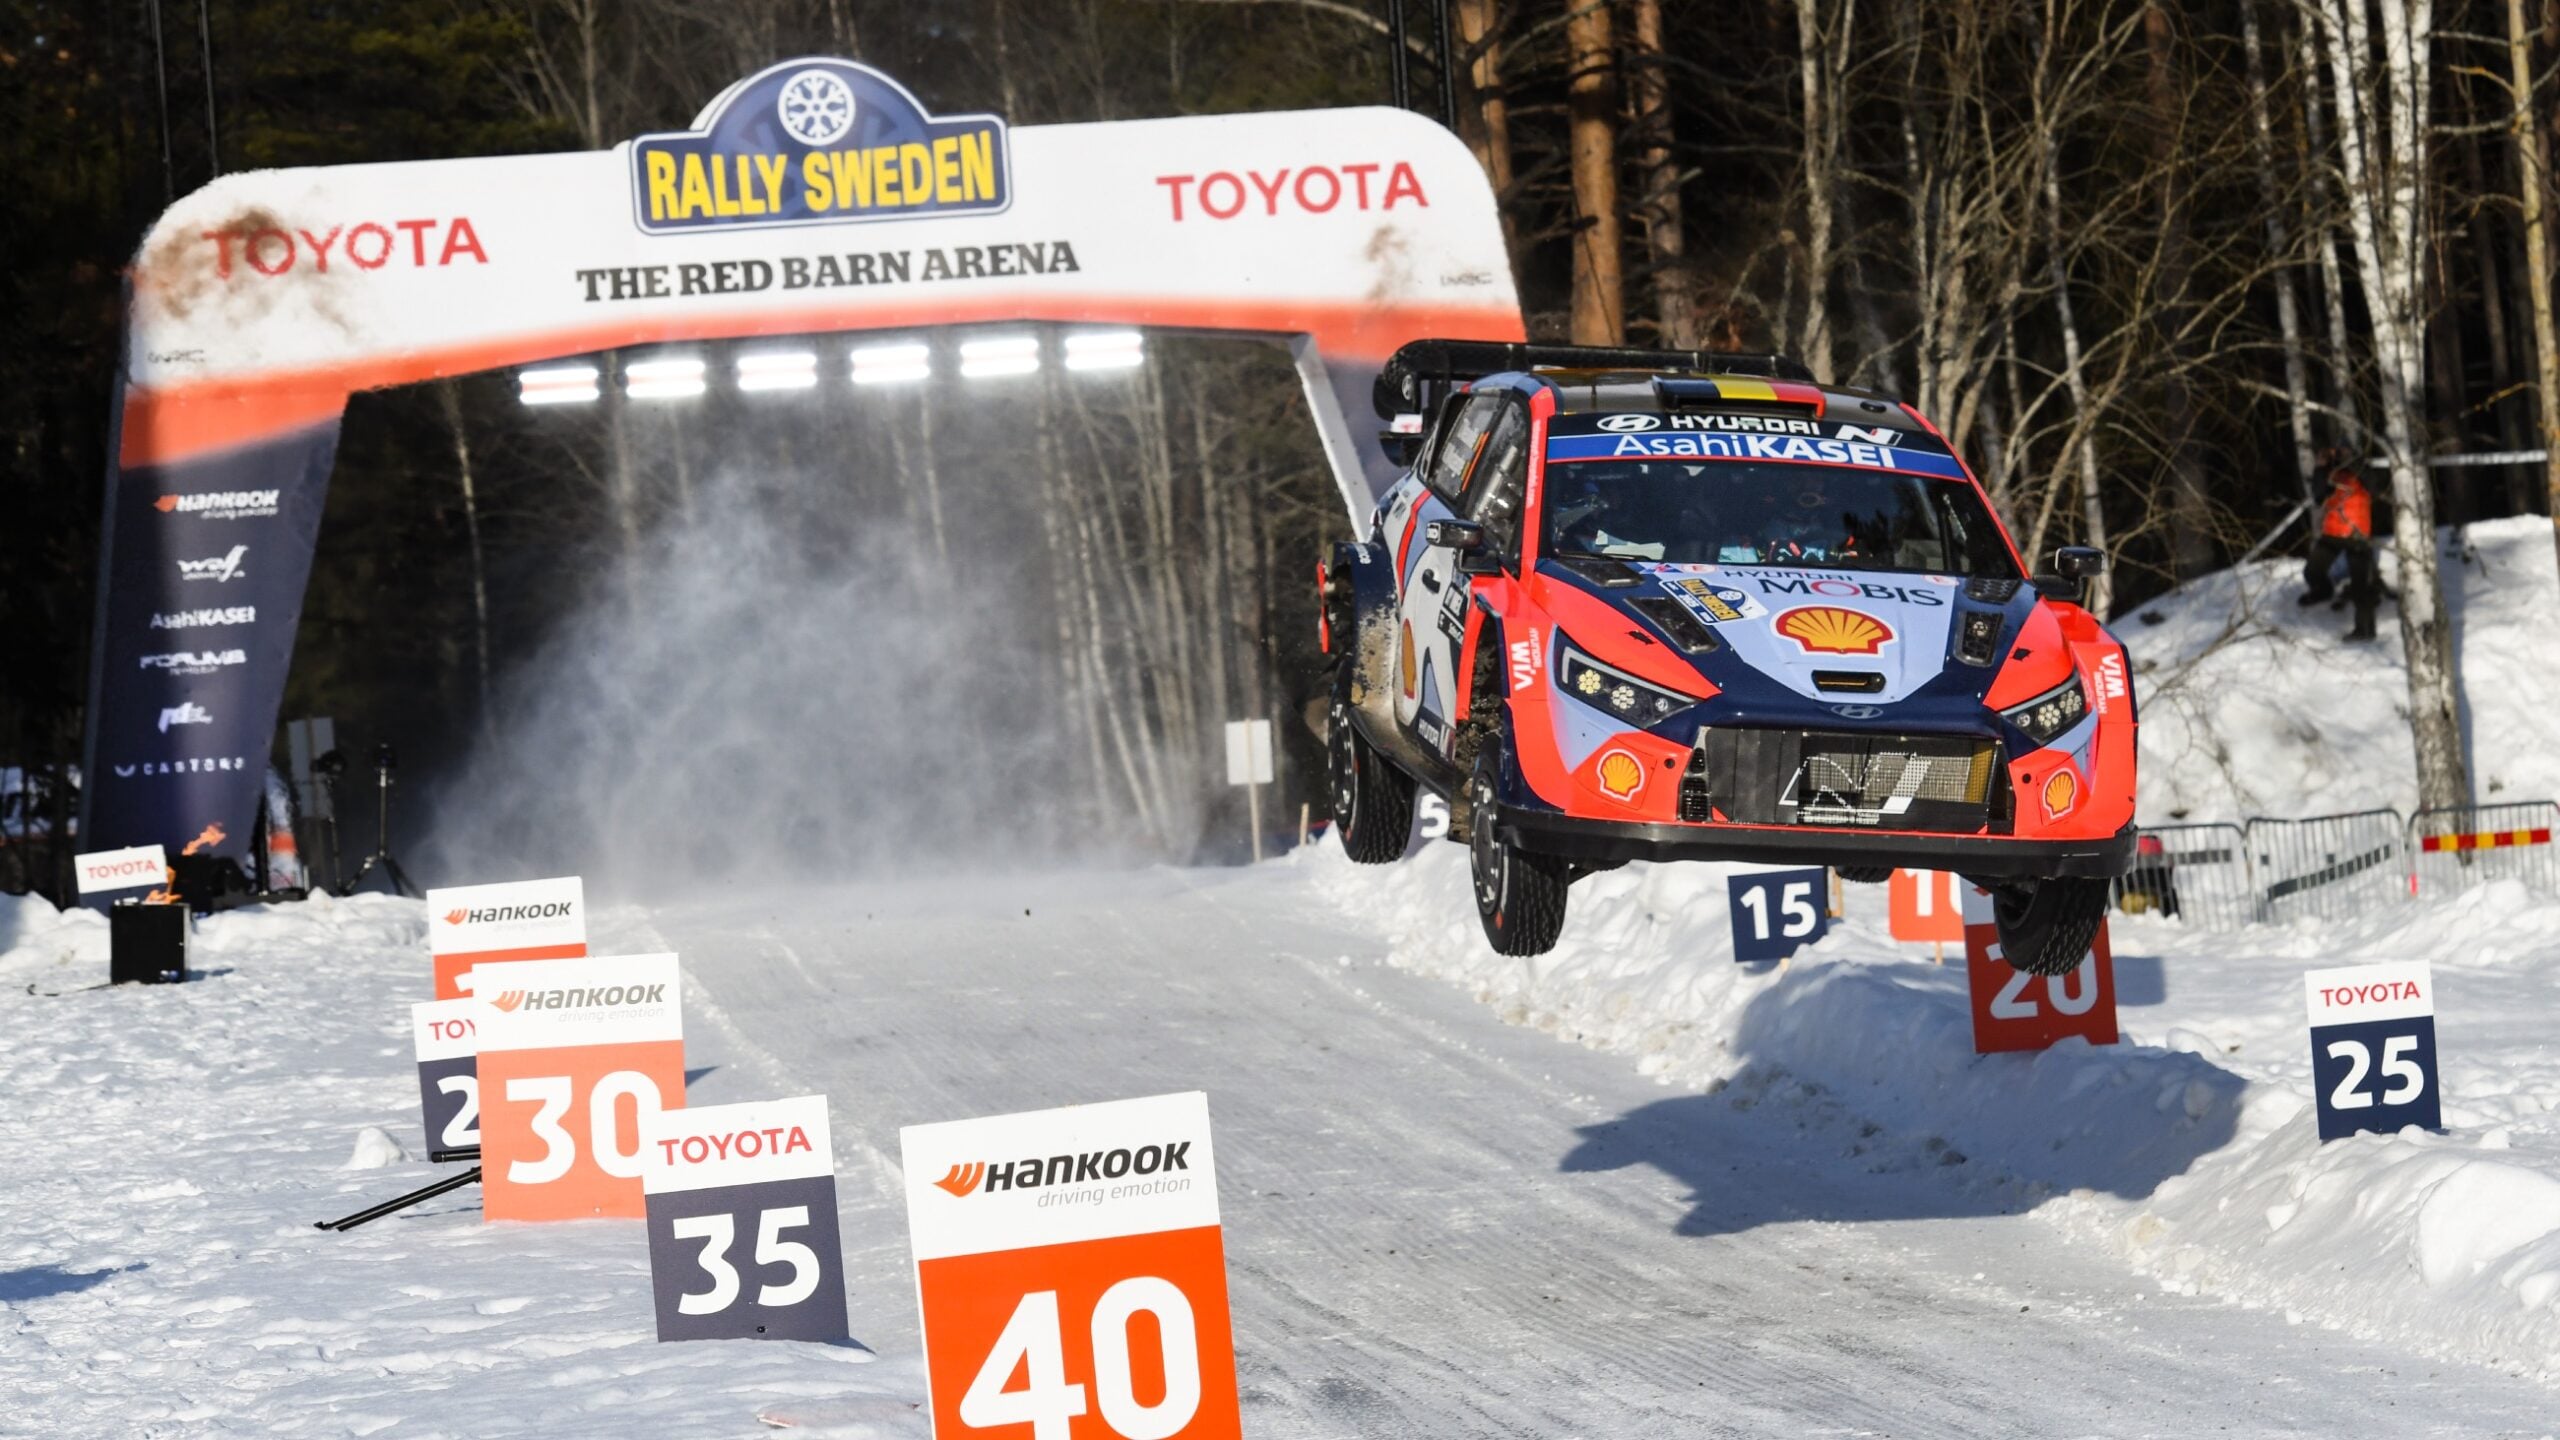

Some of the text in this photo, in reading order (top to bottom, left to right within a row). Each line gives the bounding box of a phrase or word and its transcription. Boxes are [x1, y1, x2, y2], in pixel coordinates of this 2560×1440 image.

[646, 129, 996, 221] RALLY SWEDEN
[1156, 161, 1429, 222] TOYOTA
[202, 217, 489, 280] TOYOTA
[576, 240, 1080, 302] THE RED BARN ARENA
[1671, 414, 1821, 436] HYUNDAI
[1613, 433, 1897, 469] AsahiKASEI
[1724, 570, 1853, 581] HYUNDAI
[1758, 578, 1944, 606] MOBIS
[150, 606, 256, 629] AsahiKASEI
[1420, 793, 1450, 838] 5
[86, 858, 158, 880] TOYOTA
[1740, 881, 1817, 940] 15
[524, 983, 666, 1011] HANKOOK
[2320, 980, 2421, 1006] TOYOTA
[558, 1006, 664, 1025] driving emotion
[2327, 1034, 2425, 1110] 25
[505, 1070, 662, 1184] 30
[657, 1125, 812, 1166] TOYOTA
[984, 1140, 1192, 1194] HANKOOK
[1037, 1176, 1191, 1209] driving emotion
[673, 1204, 820, 1315] 35
[960, 1276, 1200, 1440] 40
